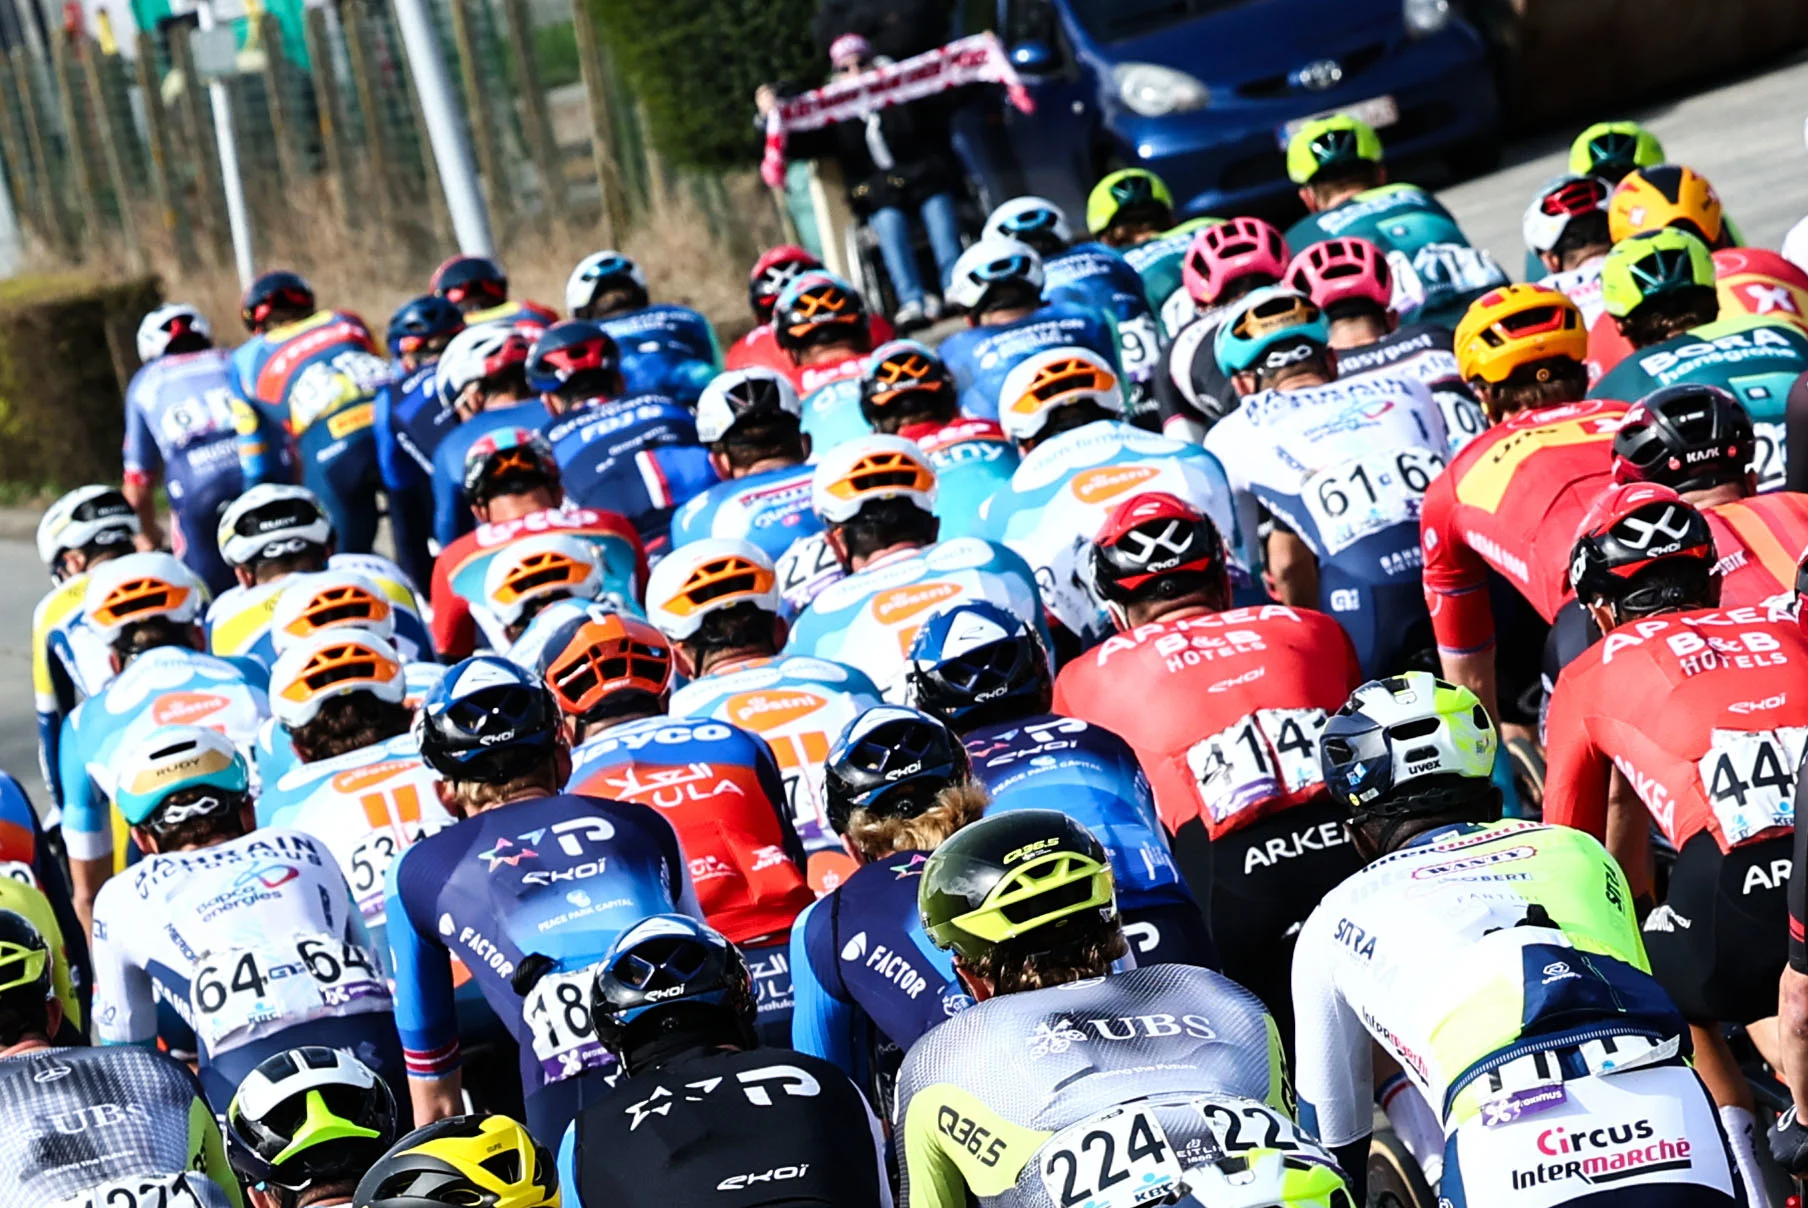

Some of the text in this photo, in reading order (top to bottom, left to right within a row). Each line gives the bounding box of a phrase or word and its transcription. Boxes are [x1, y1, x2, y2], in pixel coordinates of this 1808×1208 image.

[1640, 328, 1789, 375] BORA
[1686, 447, 1719, 463] KASK
[1318, 464, 1378, 518] 61
[1153, 629, 1259, 659] B&B
[1166, 640, 1268, 674] HOTELS
[1665, 631, 1781, 657] B&B
[1681, 651, 1788, 678] HOTELS
[155, 758, 201, 779] RUDY
[1408, 758, 1442, 775] uvex
[1707, 740, 1794, 808] 44
[1614, 755, 1676, 844] ARKEA
[134, 833, 316, 894] BAHRAIN
[458, 926, 516, 979] FACTOR
[1334, 916, 1378, 962] SITRA
[196, 952, 267, 1014] 64
[302, 939, 372, 986] 64
[865, 944, 928, 1001] FACTOR
[1088, 1013, 1217, 1041] UBS
[46, 1103, 146, 1135] UBS
[1536, 1116, 1655, 1157] Circus
[1134, 1181, 1175, 1204] KBC
